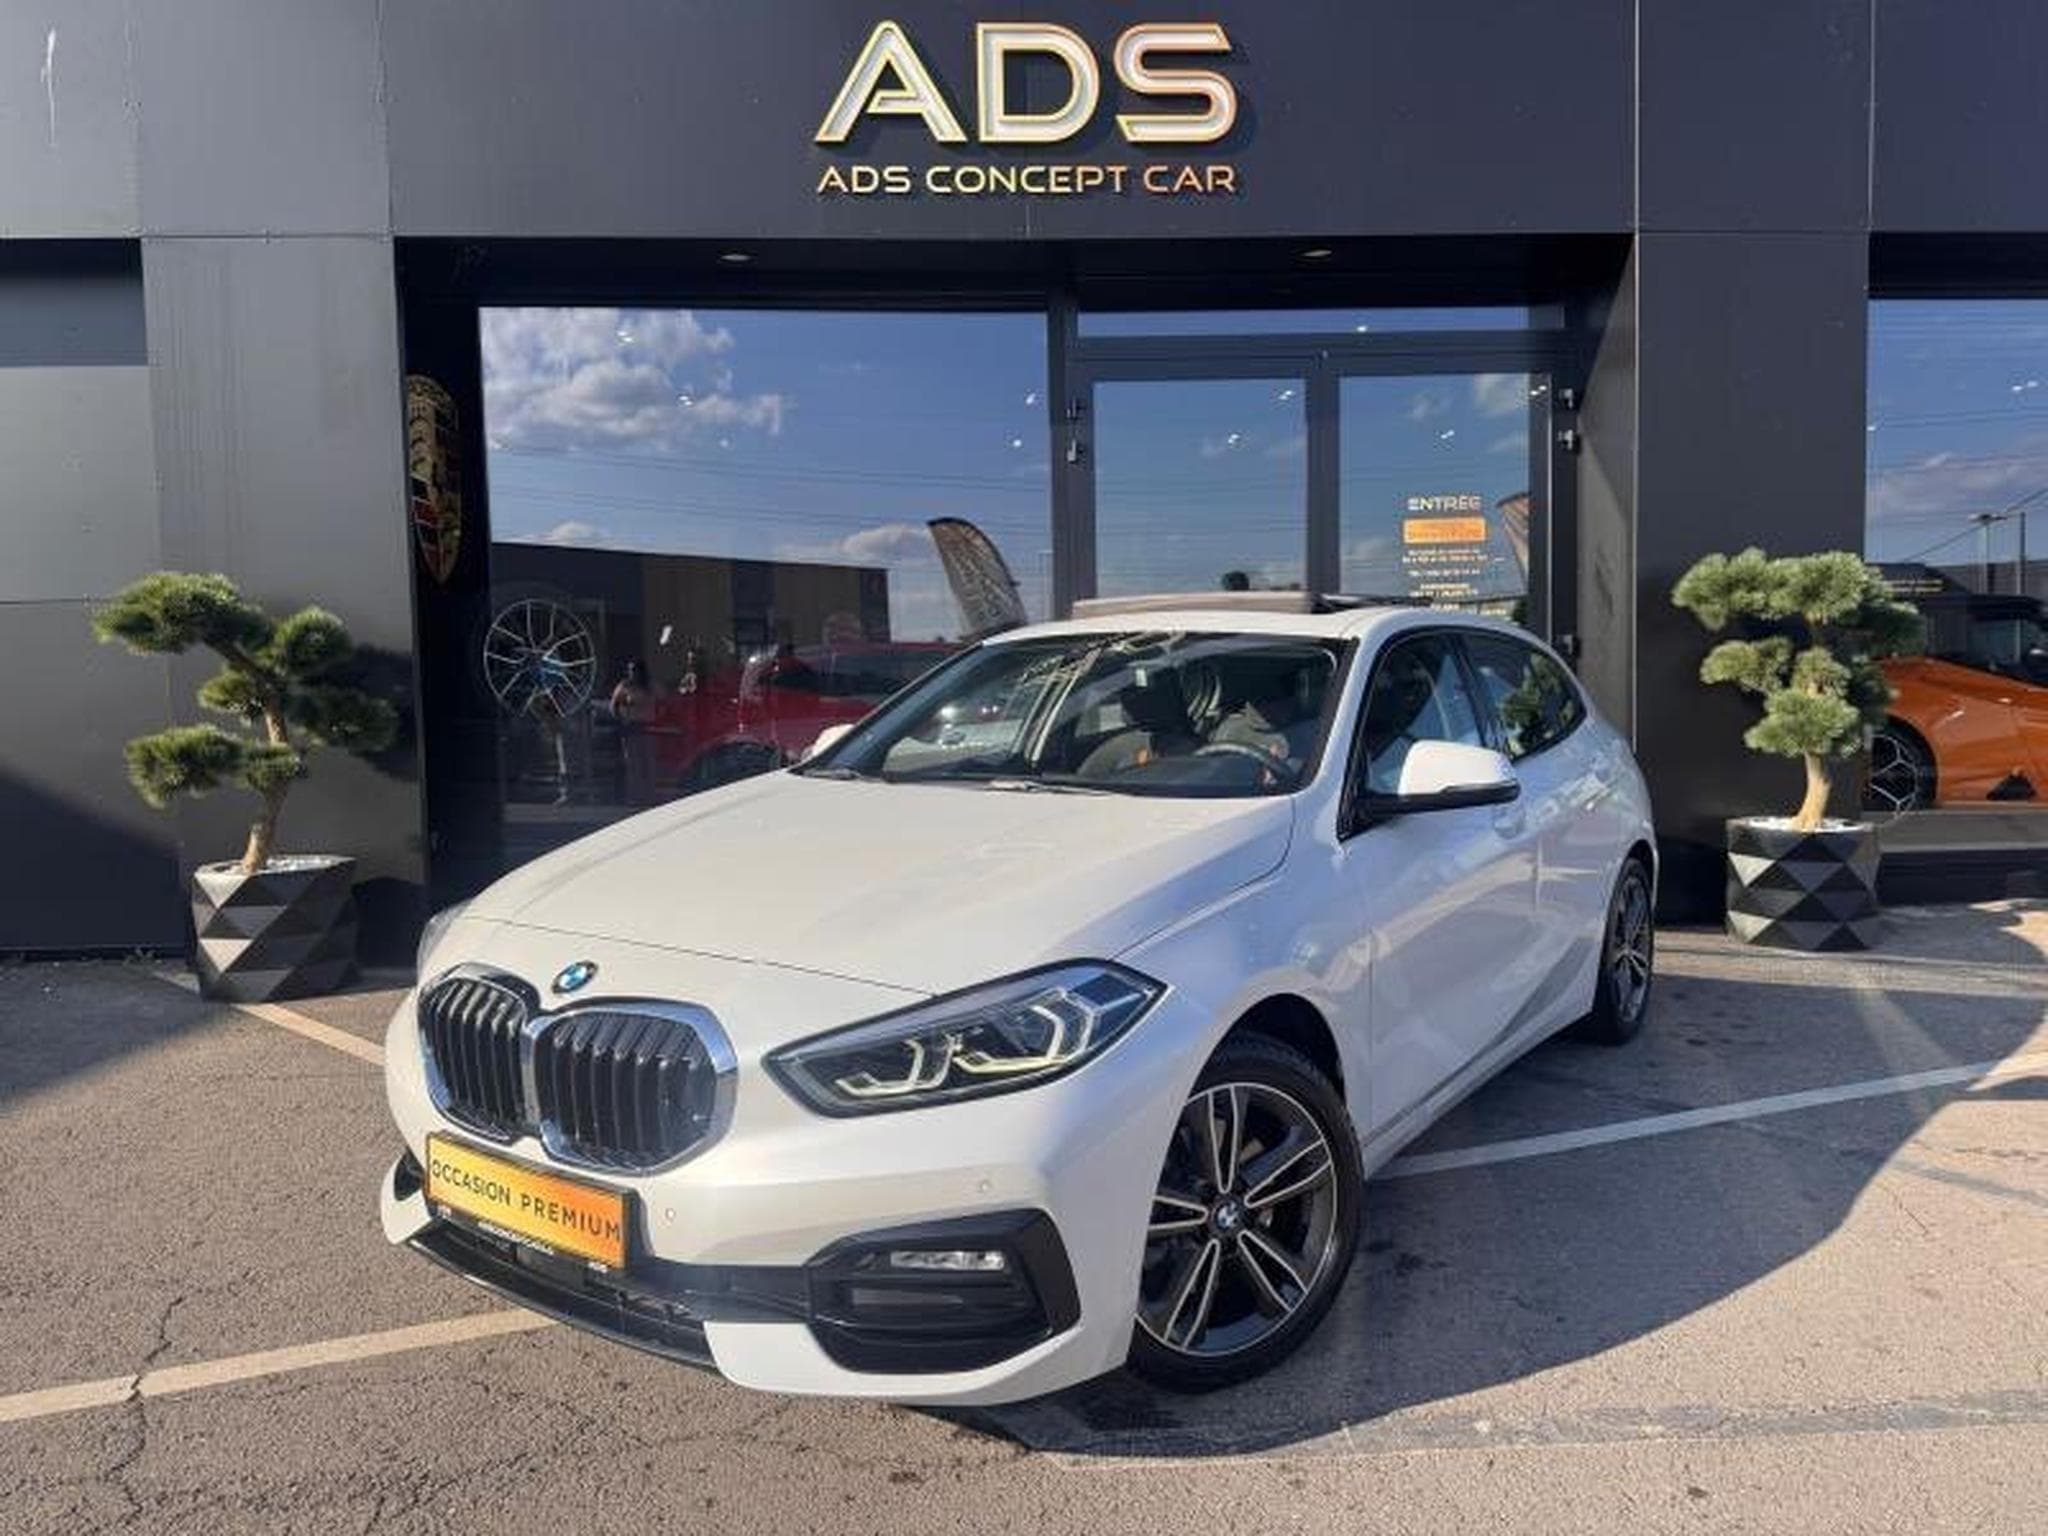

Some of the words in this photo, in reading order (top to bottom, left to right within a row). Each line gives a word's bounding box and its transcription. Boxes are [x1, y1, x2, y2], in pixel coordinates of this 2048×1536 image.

[815, 20, 1237, 142] ADS
[817, 166, 911, 193] ADS
[926, 166, 1127, 193] CONCEPT
[1143, 166, 1235, 193] CAR
[431, 1160, 511, 1207] OCCASION
[520, 1194, 621, 1241] PREMIUM
